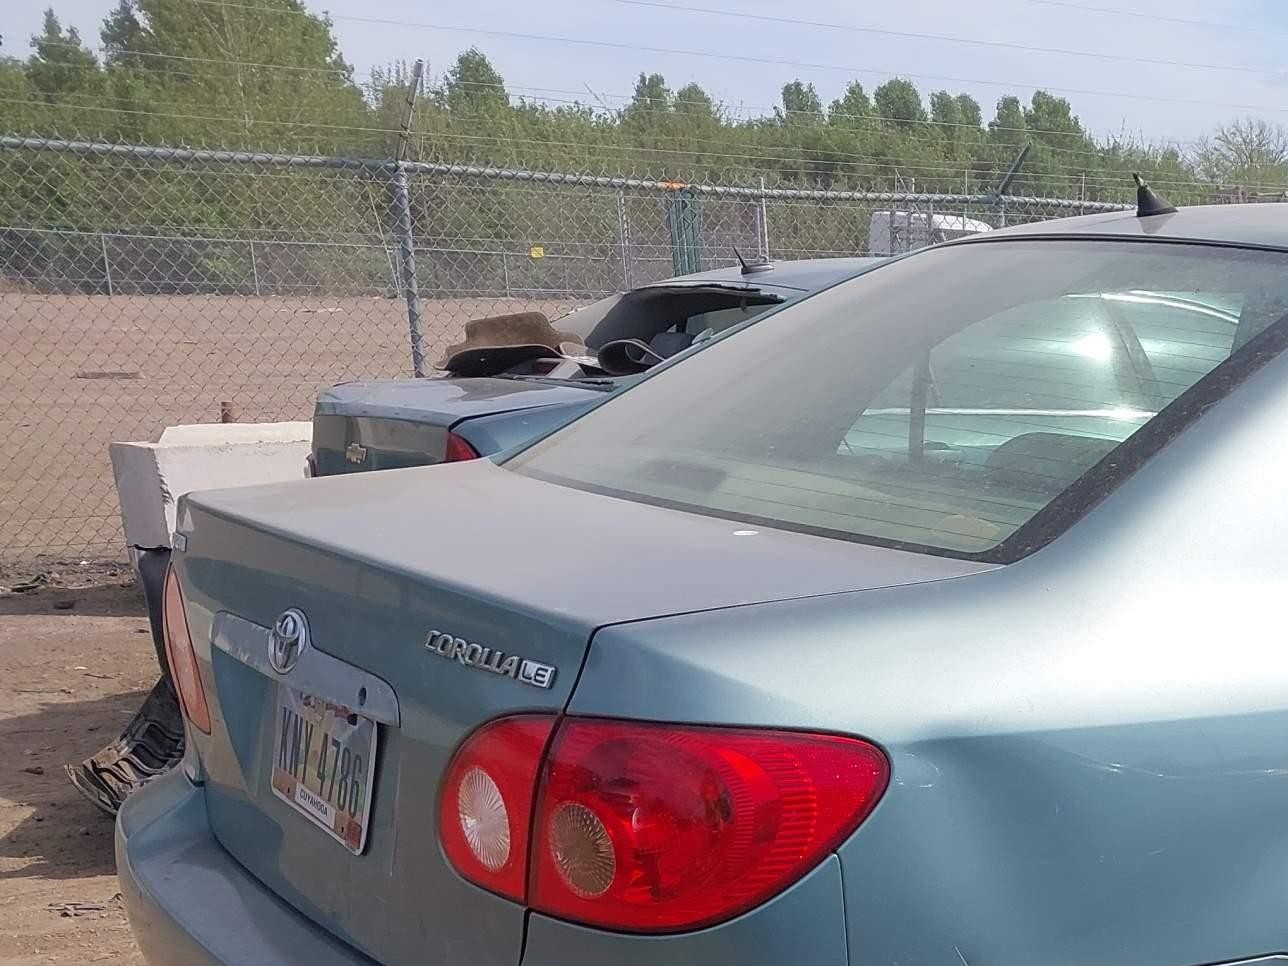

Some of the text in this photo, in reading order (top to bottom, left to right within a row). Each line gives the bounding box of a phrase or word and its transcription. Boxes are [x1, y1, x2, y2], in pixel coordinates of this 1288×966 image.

[424, 630, 552, 685] COROLLA LE
[278, 706, 362, 819] KNY 4786
